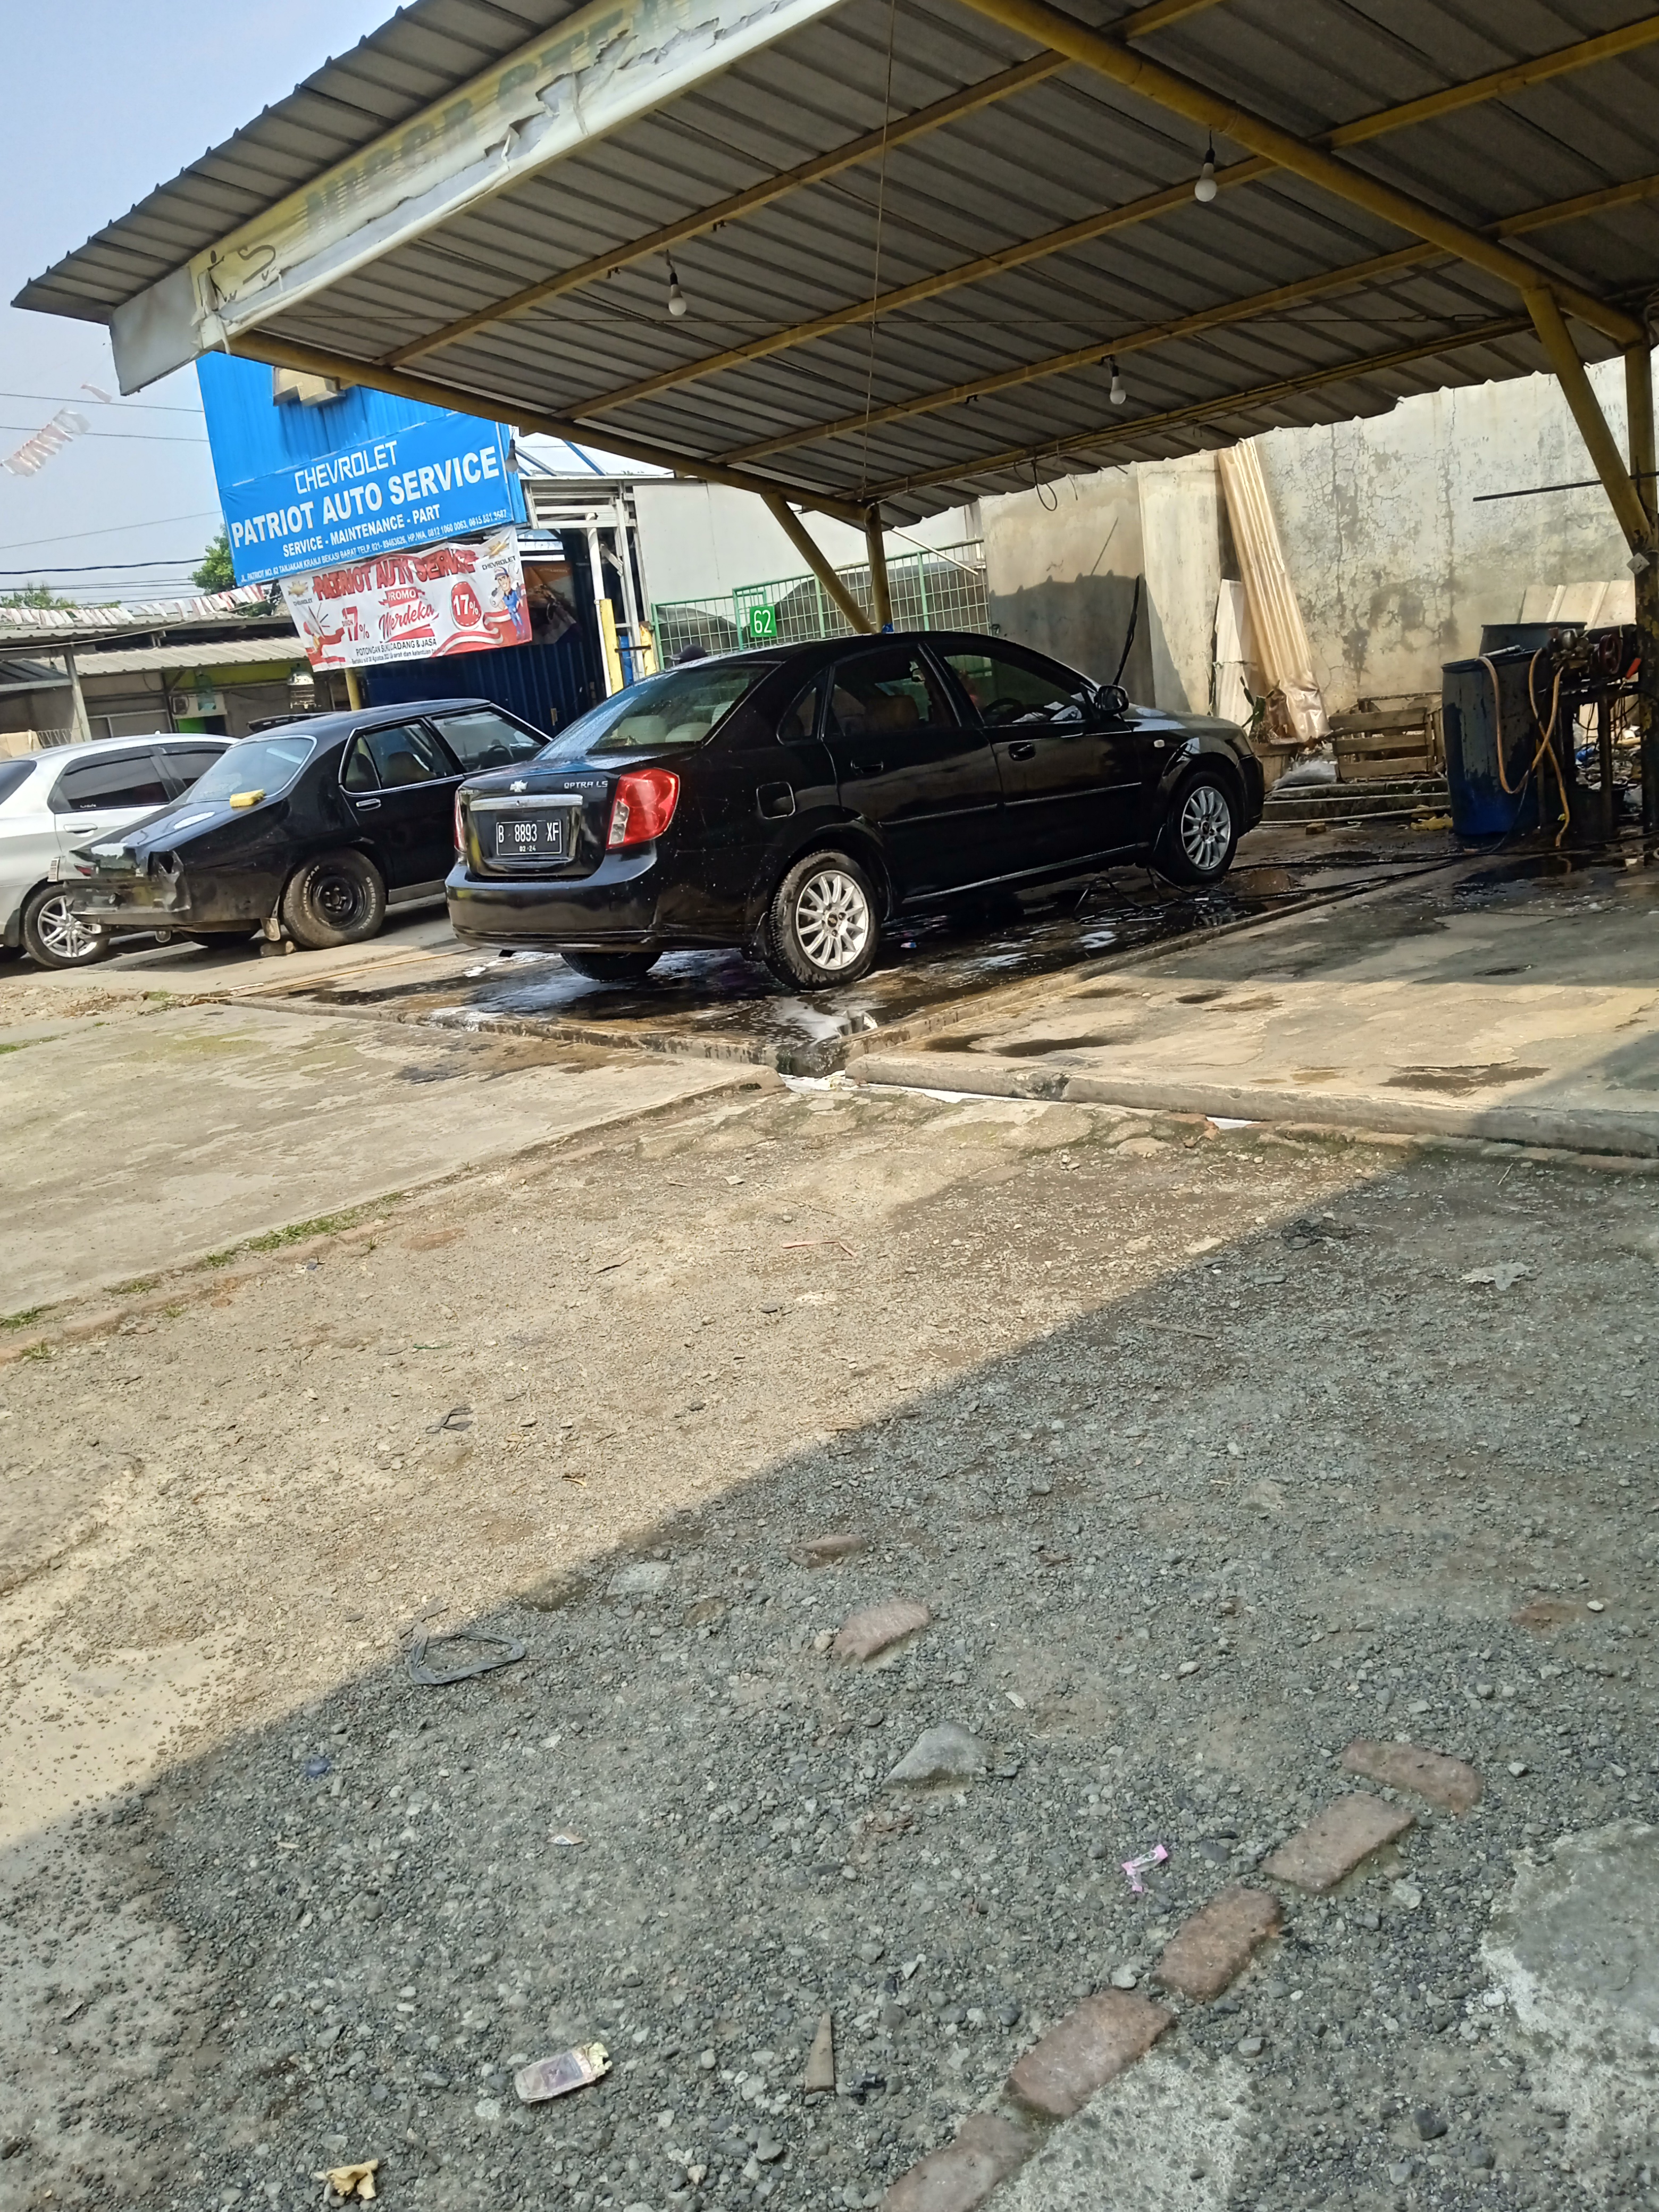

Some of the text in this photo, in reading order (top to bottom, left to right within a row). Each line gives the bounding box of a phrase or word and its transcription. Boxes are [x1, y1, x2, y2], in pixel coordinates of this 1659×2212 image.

[295, 440, 397, 494] CHEVROLET
[231, 446, 499, 548] PATRIOT AUTO SERVICE
[247, 569, 264, 580] PATRIOT
[279, 561, 303, 573] TANJAKAN
[303, 556, 321, 568] KRANJI
[322, 554, 340, 564] BEKASI
[341, 548, 357, 559] BARAT
[357, 544, 372, 555] TELP.
[428, 526, 440, 538] 0812
[441, 524, 453, 534] 1060
[469, 516, 482, 527] 0815
[283, 536, 323, 557] SERVICE
[330, 514, 405, 546] MAINTENANCE
[412, 504, 440, 525] PART
[482, 556, 516, 571] CHEVROLET
[312, 565, 372, 601] PATRIOT
[388, 590, 416, 601] PROMO
[379, 601, 434, 640] Merdeka
[754, 610, 772, 633] 62
[356, 645, 380, 656] POTONGAN
[498, 823, 559, 843] B 8893 XF
